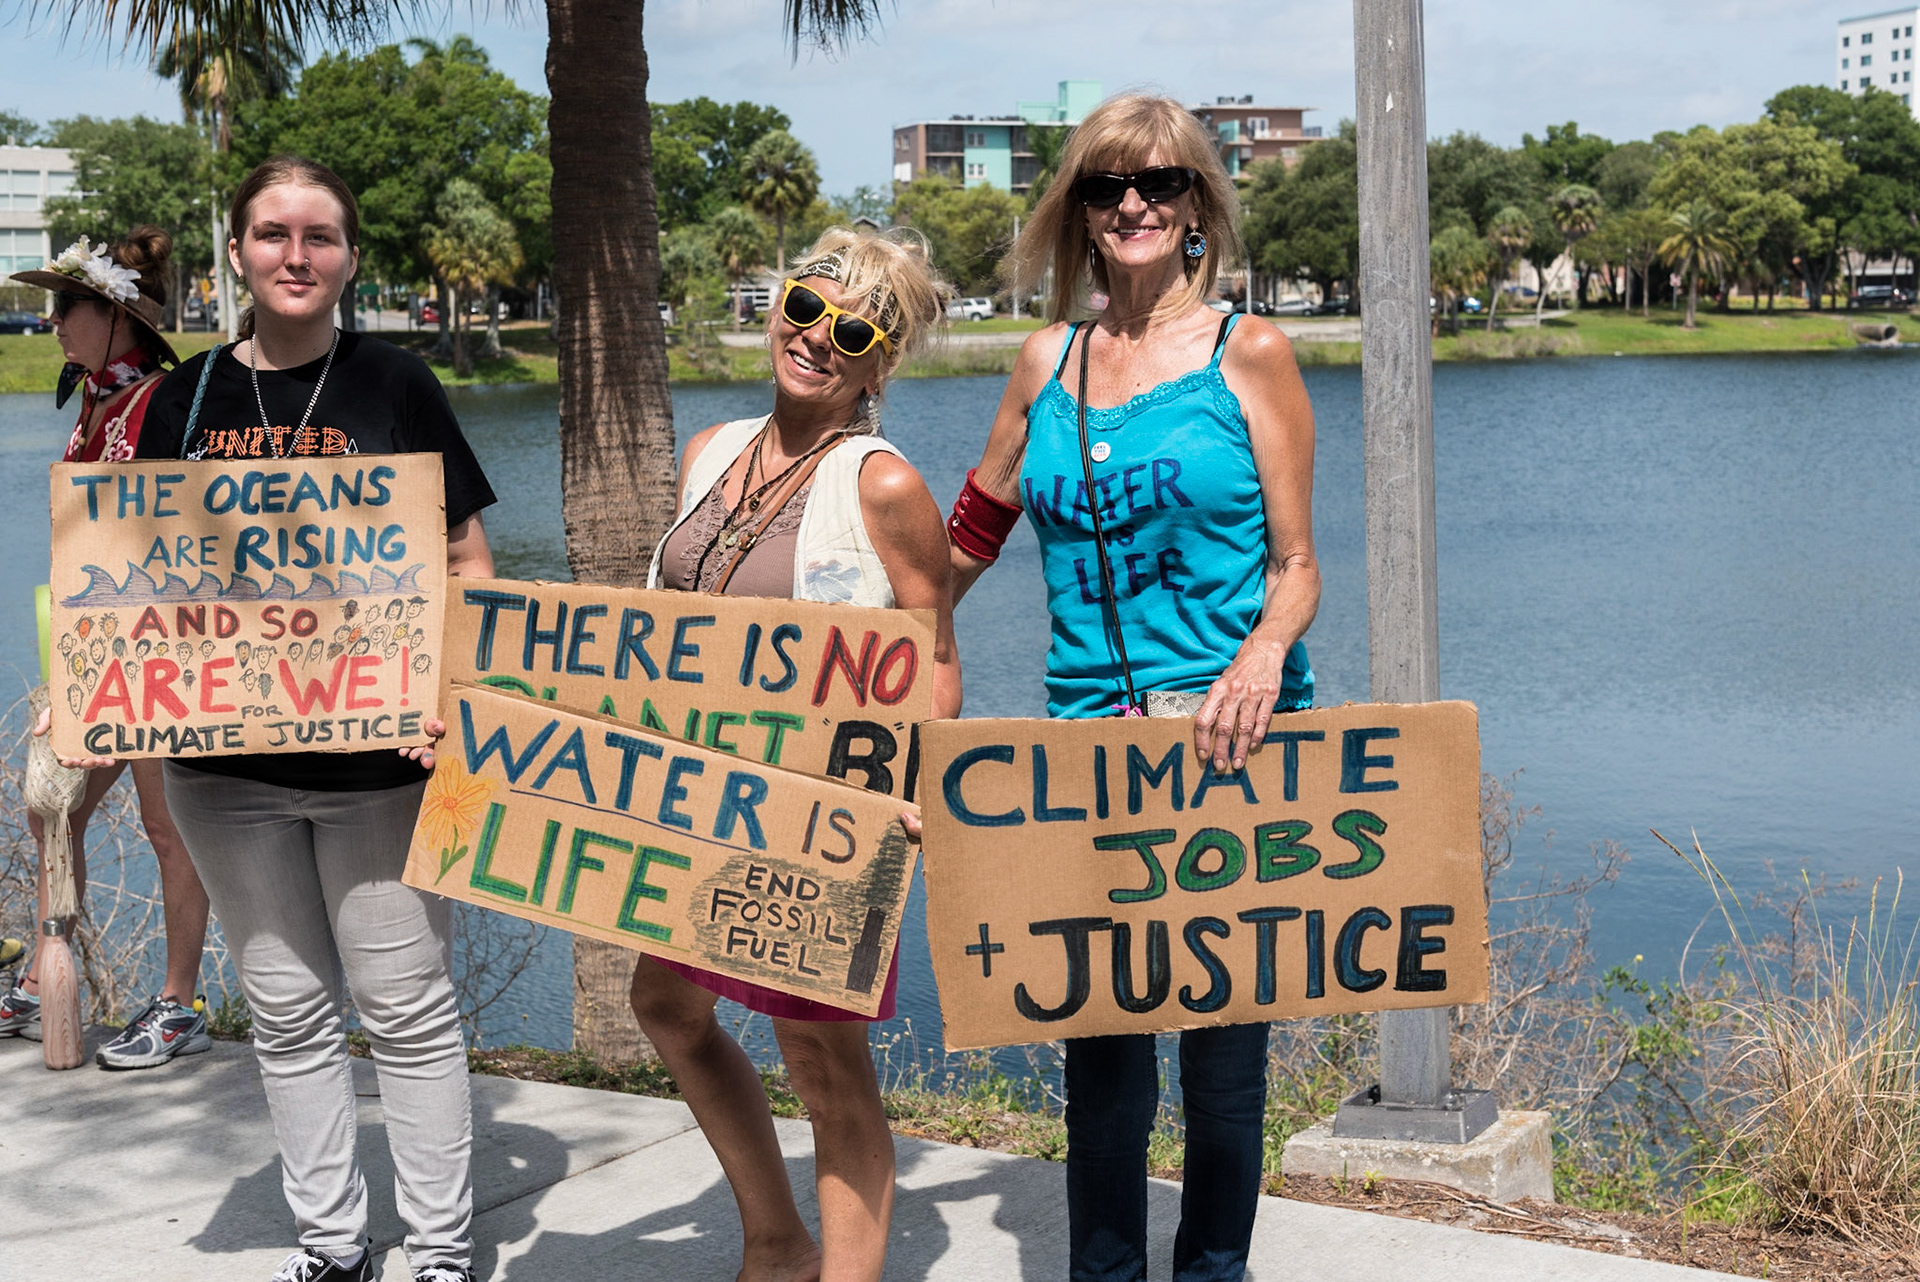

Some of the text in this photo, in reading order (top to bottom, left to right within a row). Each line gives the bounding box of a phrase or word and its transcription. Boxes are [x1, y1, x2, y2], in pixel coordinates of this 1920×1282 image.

[204, 426, 348, 457] UNITED
[72, 465, 397, 521] THE OCEANS
[1023, 457, 1195, 527] WATER
[142, 524, 407, 573] ARE RISING
[1104, 525, 1135, 547] IS
[1072, 547, 1185, 605] LIFE
[130, 603, 319, 641] AND SO
[463, 590, 918, 707] THERE IS NO
[82, 646, 410, 725] ARE WE!
[241, 704, 283, 719] FOR
[84, 710, 424, 755] CLIMATE JUSTICE
[474, 675, 805, 765] NET
[459, 698, 857, 864] WATER IS
[942, 726, 1400, 828] CLIMATE
[469, 801, 691, 943] LIFE
[744, 863, 821, 902] END
[1093, 809, 1388, 903] JOBS
[709, 886, 847, 946] FOSSIL
[726, 926, 822, 977] FUEL
[964, 904, 1455, 1023] + JUSTICE
